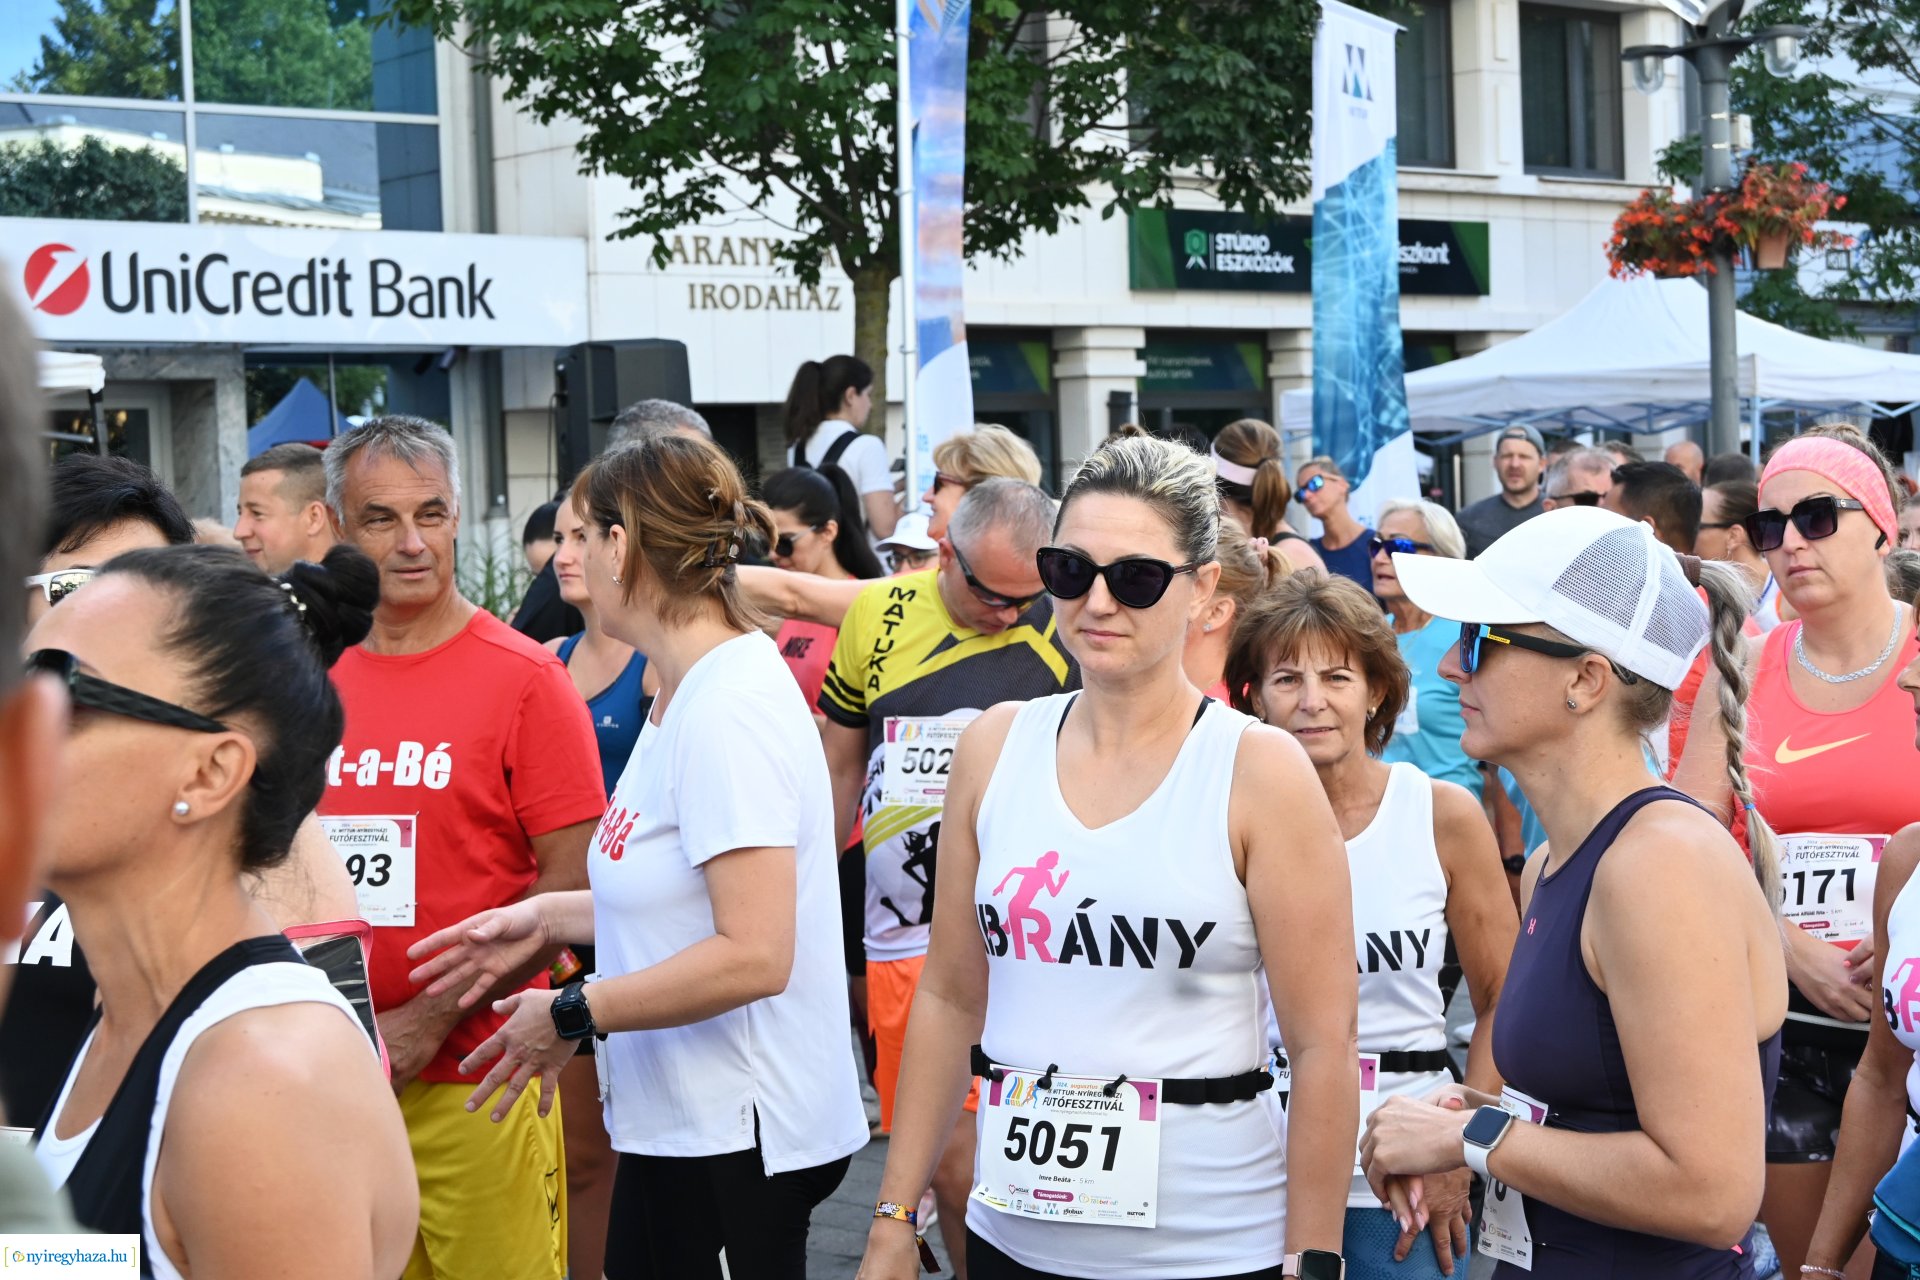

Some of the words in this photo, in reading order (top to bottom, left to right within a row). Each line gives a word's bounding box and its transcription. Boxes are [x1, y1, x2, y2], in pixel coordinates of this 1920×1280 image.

[101, 251, 354, 317] UniCredit
[369, 258, 496, 320] Bank
[868, 586, 917, 692] MATUKA
[325, 741, 452, 790] t-a-Bé
[1796, 851, 1861, 859] FUTÓFESZTIVÁL
[1357, 928, 1431, 974] NY
[1042, 1096, 1125, 1112] FUTÓFESZTIVÁL
[1004, 1116, 1122, 1172] 5051
[1053, 1175, 1072, 1183] Beáta
